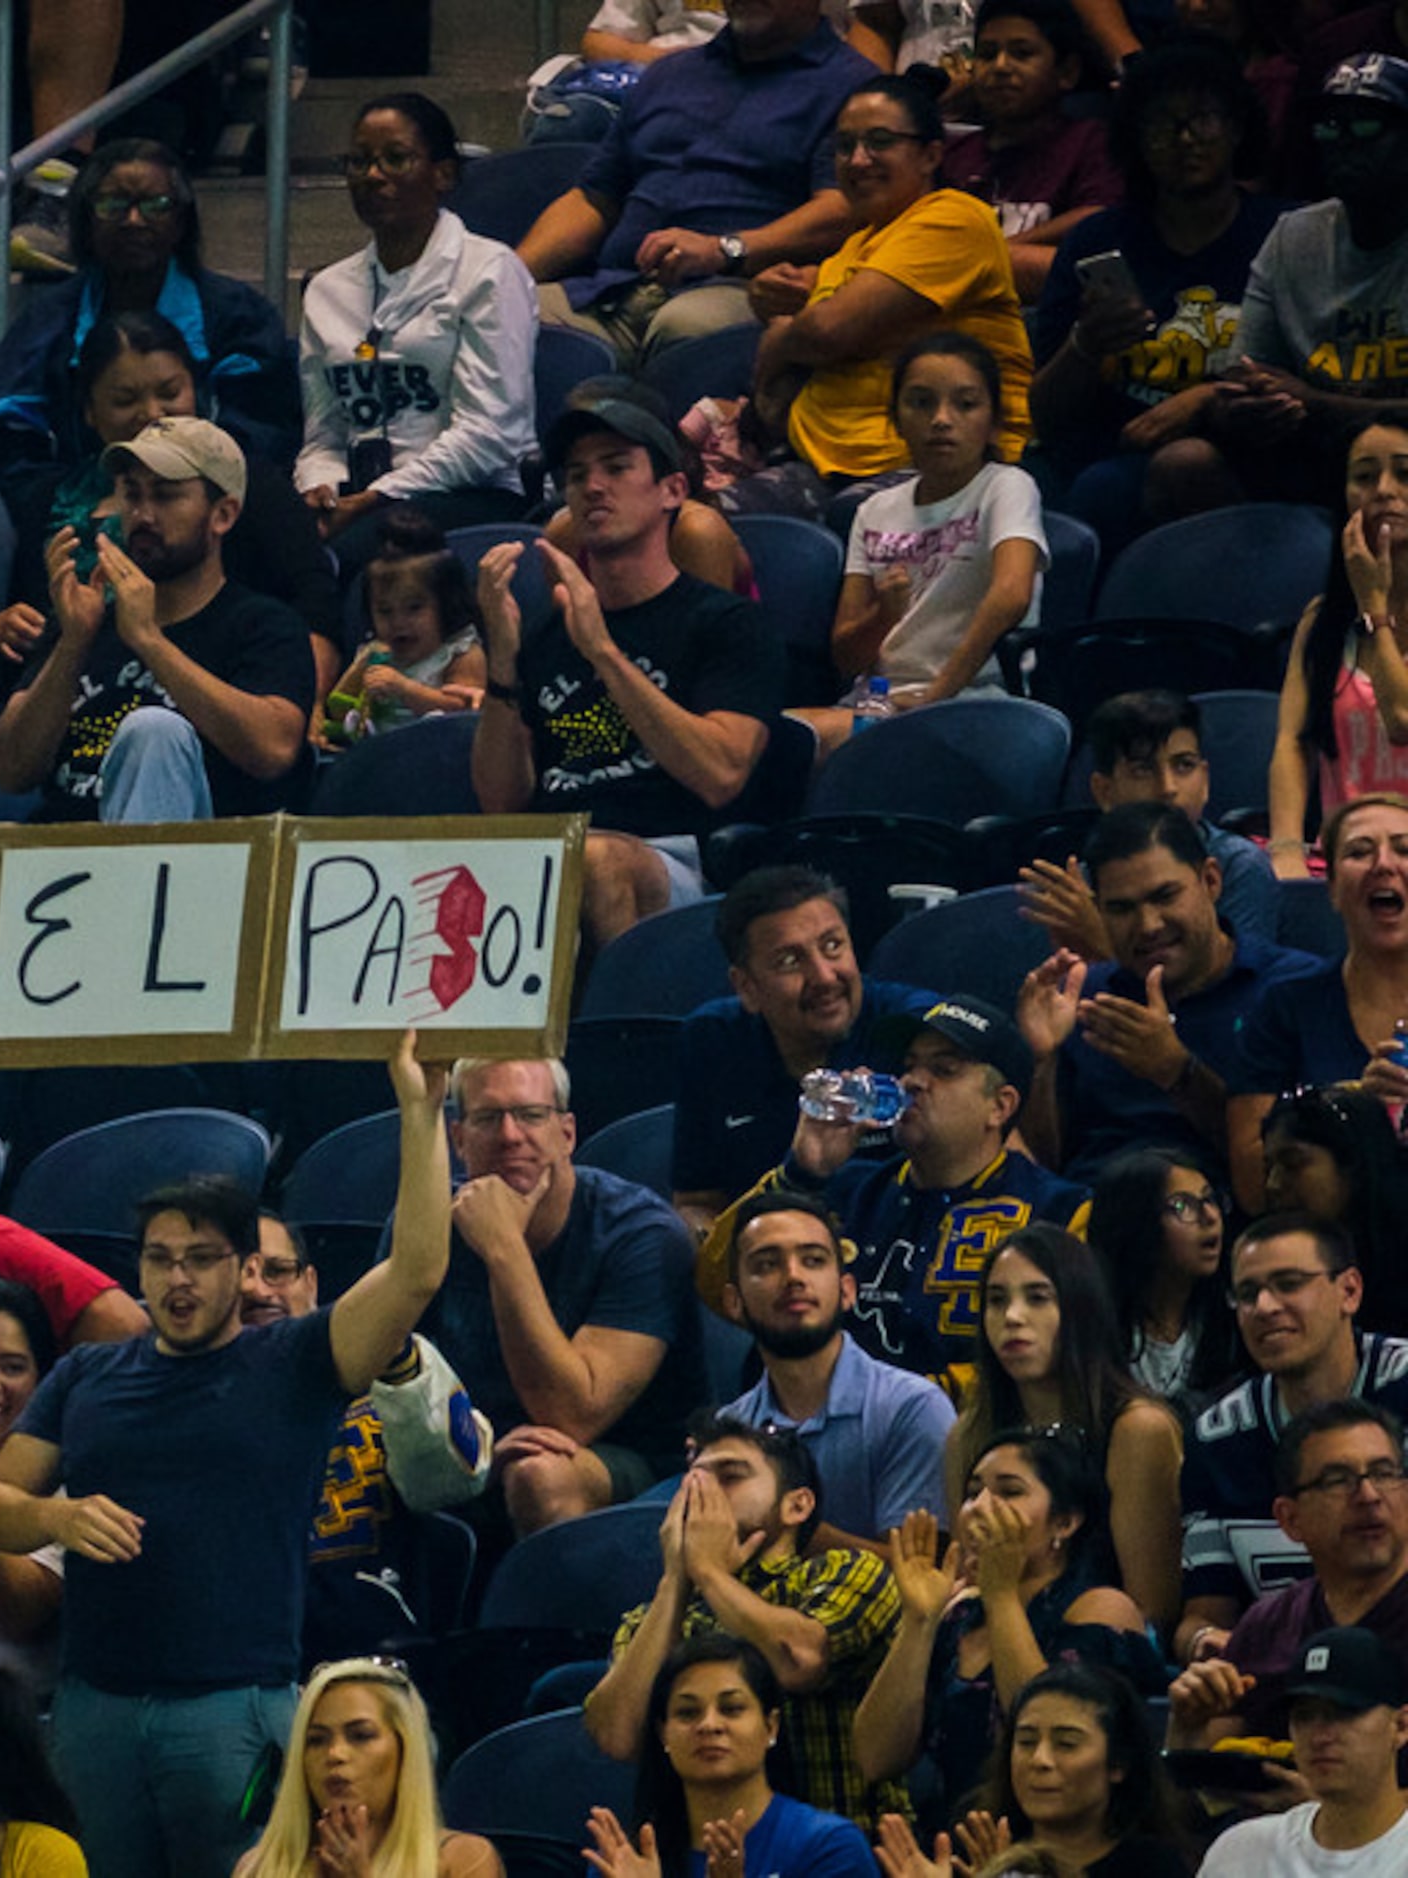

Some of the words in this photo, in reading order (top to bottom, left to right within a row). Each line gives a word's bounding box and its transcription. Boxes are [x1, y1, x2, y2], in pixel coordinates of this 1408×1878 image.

[538, 673, 583, 714] EL
[18, 862, 206, 1006] EL
[296, 855, 554, 1021] PASO!
